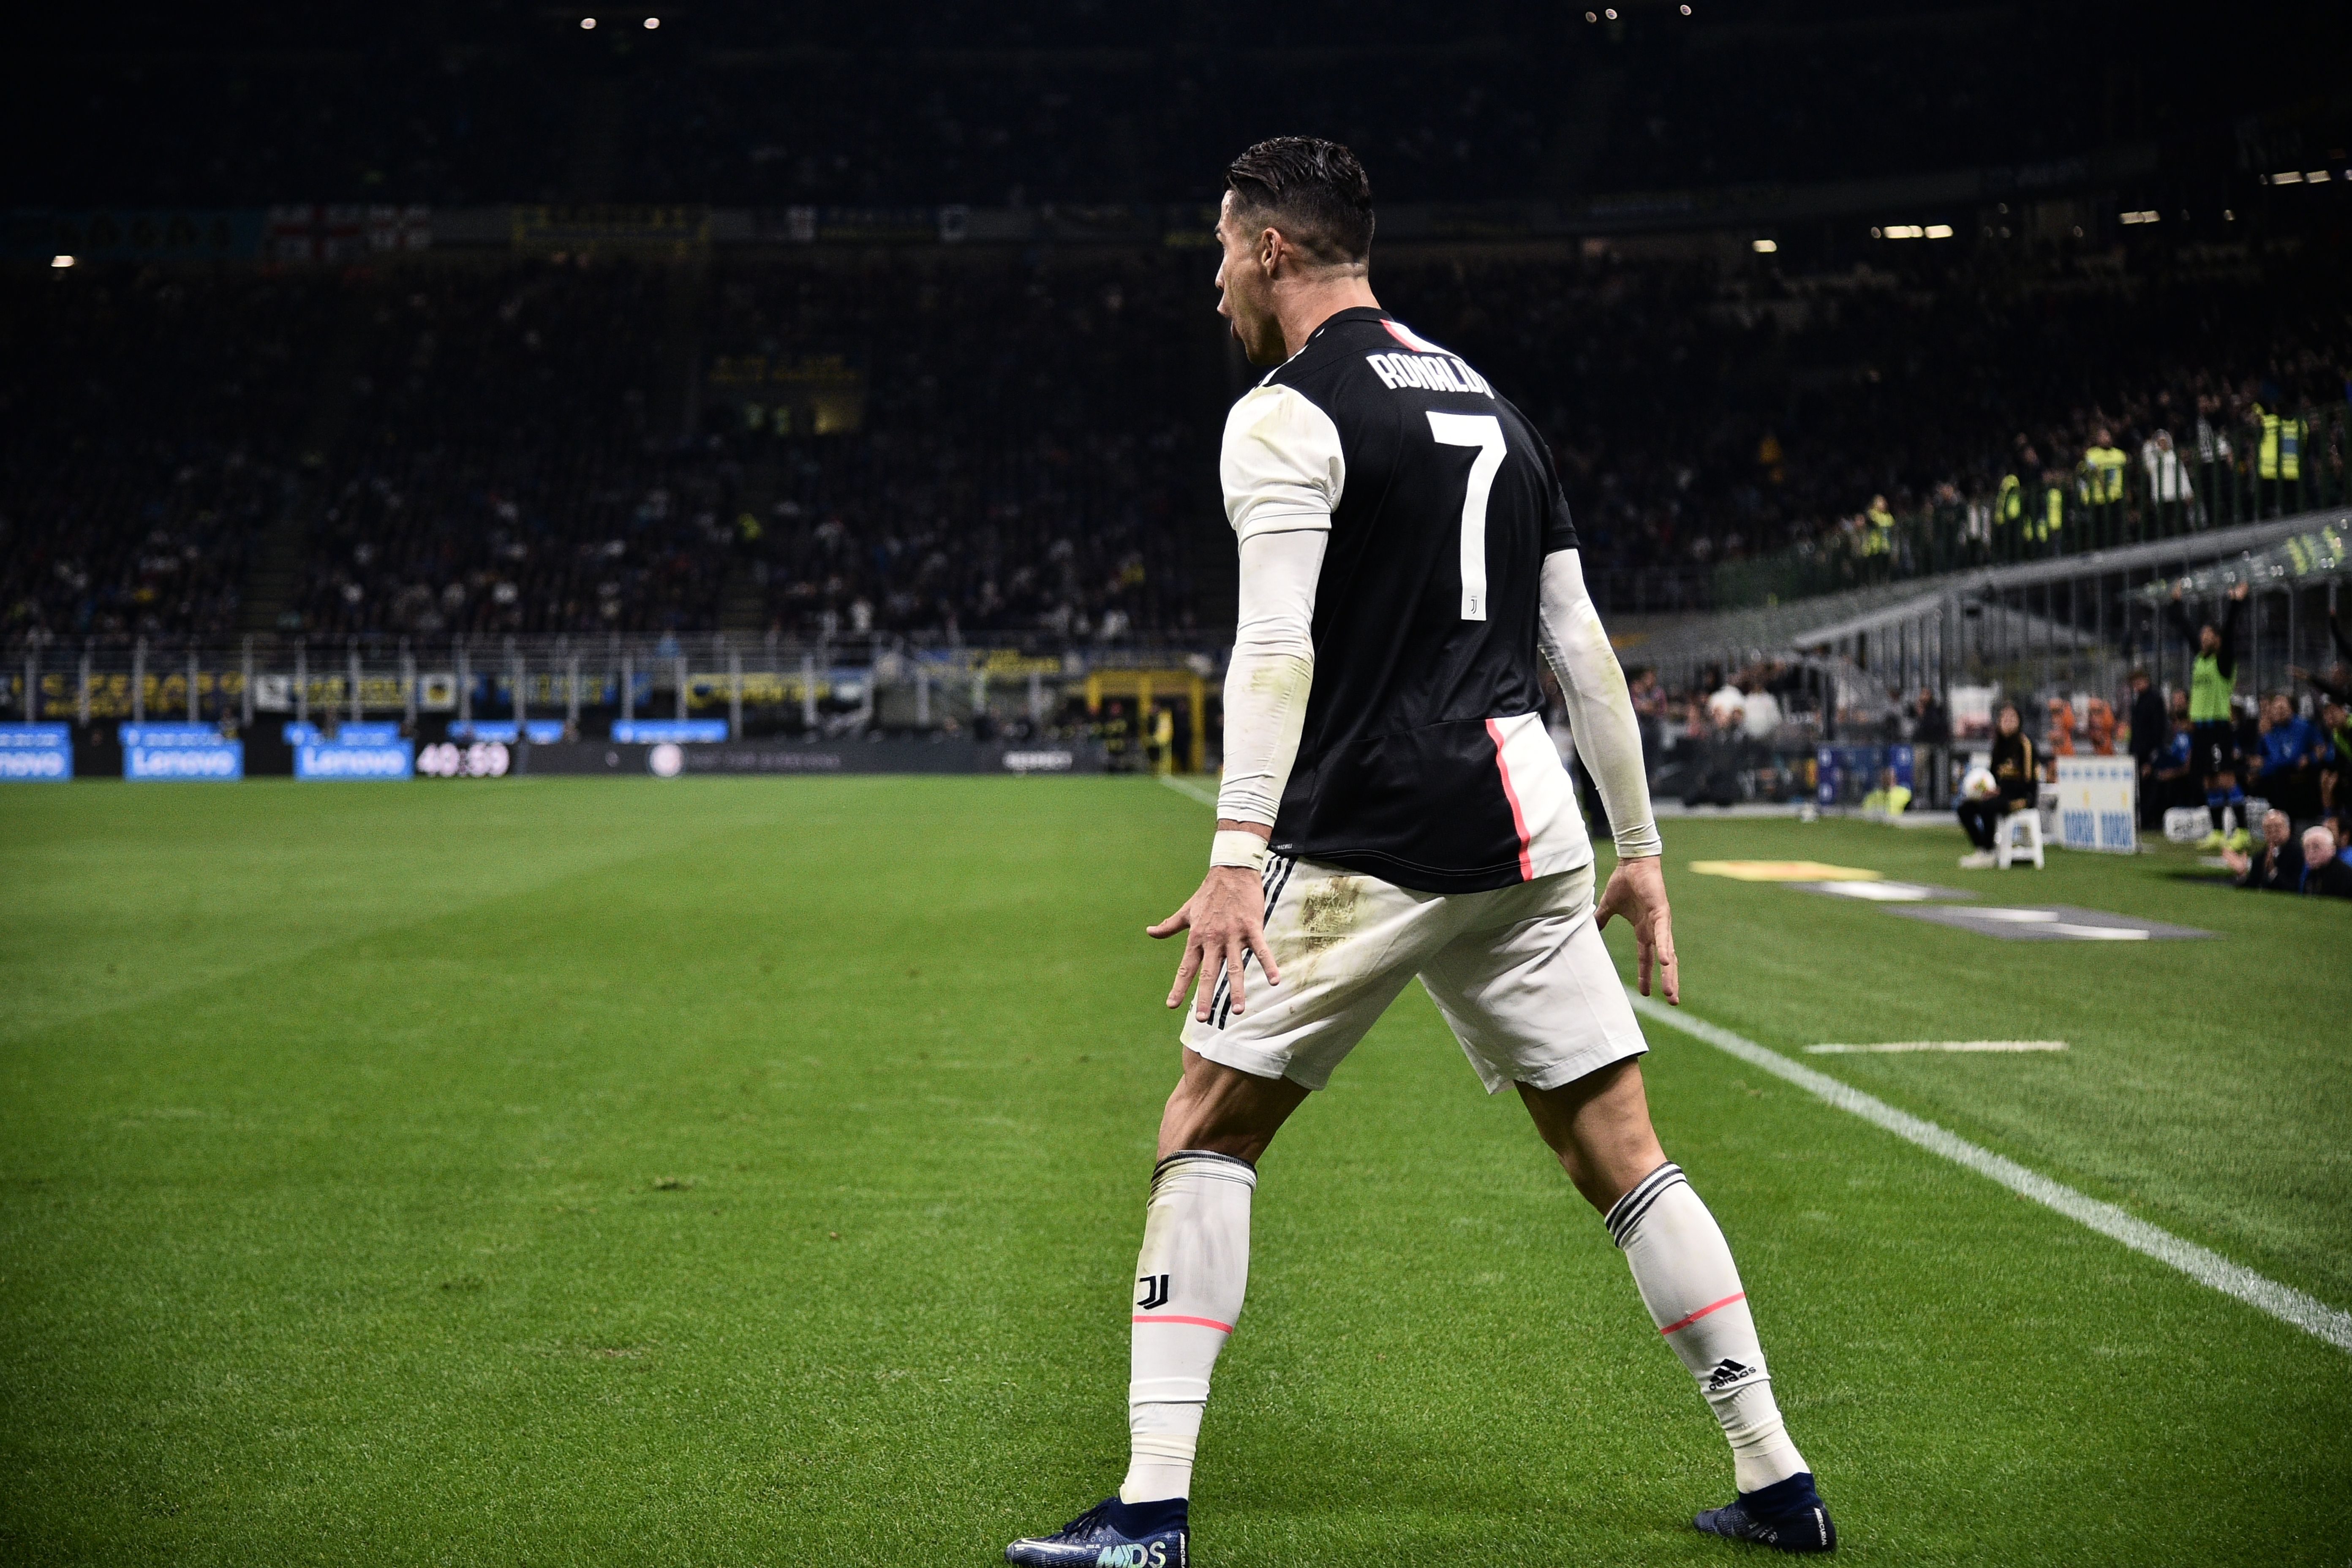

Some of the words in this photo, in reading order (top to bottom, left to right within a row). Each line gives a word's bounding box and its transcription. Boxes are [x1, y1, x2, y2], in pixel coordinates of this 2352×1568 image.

[1366, 353, 1495, 399] RONALDO
[1426, 411, 1508, 621] 7
[133, 746, 237, 776] Lenovo
[302, 746, 407, 776] Lenovo
[1709, 1367, 1756, 1391] adidas
[1814, 1508, 1827, 1546] MERCURIAL
[1096, 1541, 1166, 1568] MDS
